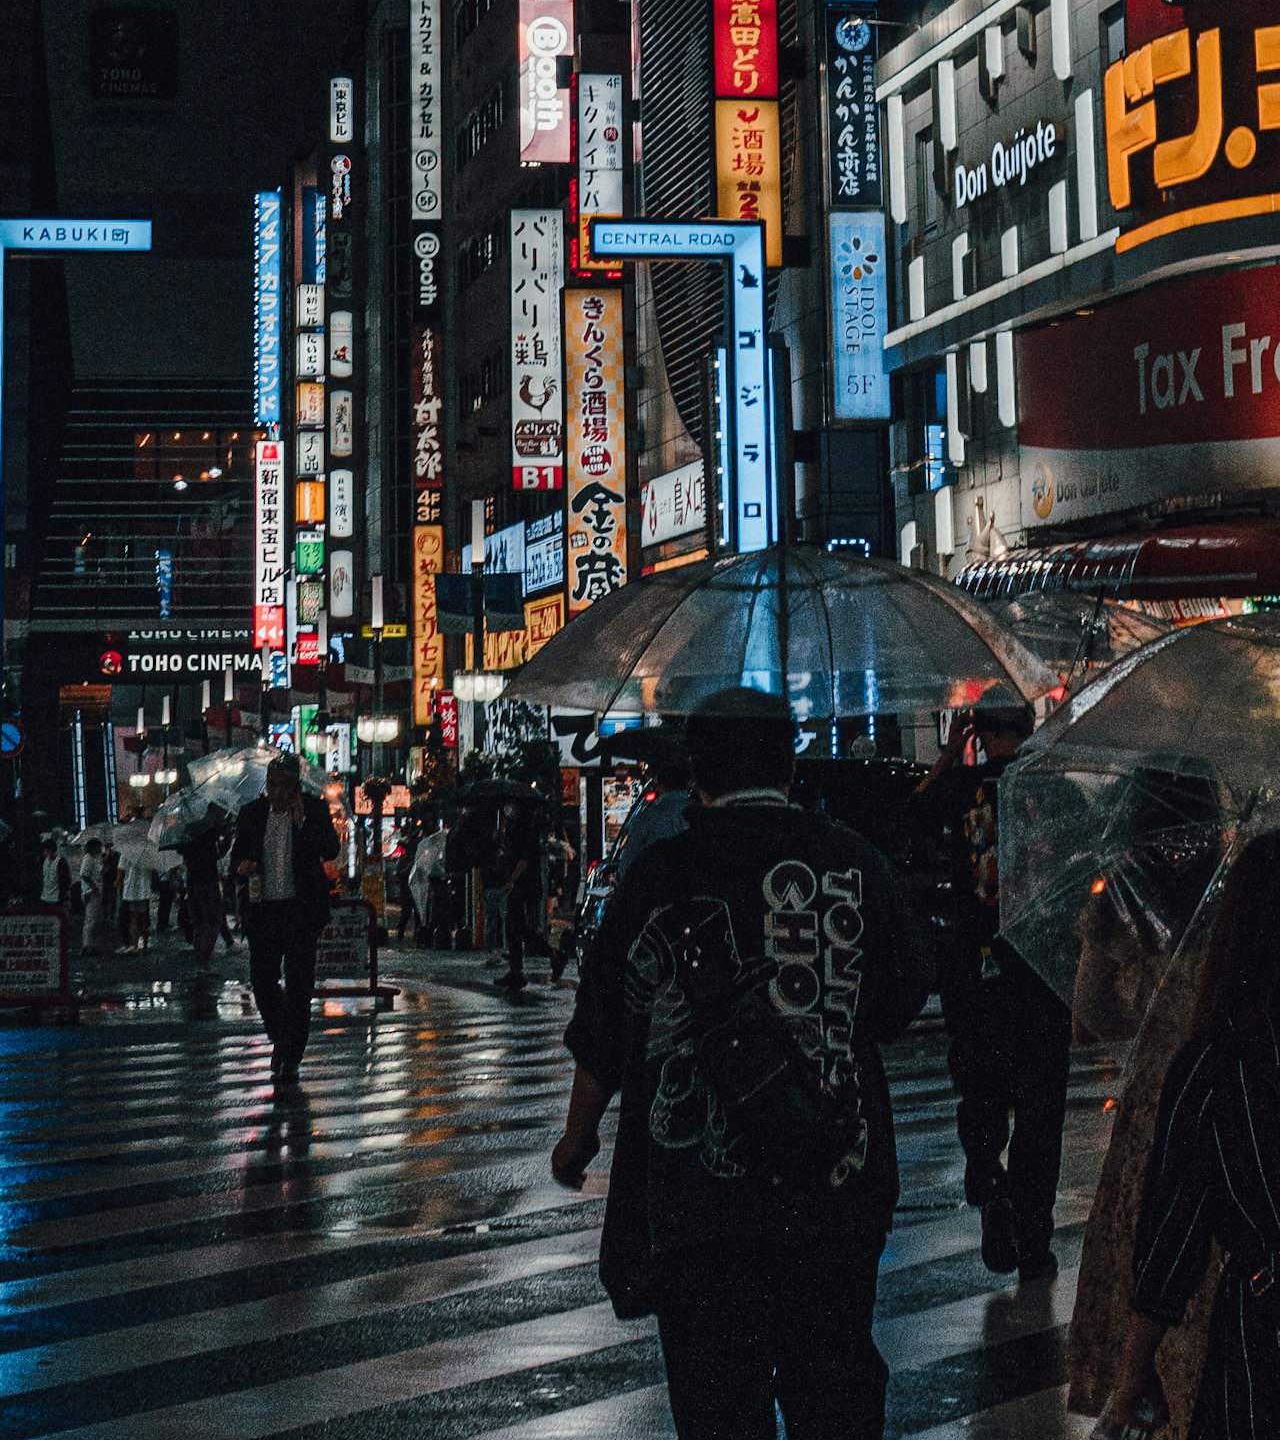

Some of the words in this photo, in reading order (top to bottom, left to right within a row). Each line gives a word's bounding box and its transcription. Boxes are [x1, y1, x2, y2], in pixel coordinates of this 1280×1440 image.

[525, 16, 568, 132] Booth
[605, 77, 620, 89] 4F
[335, 90, 348, 136] 東京ビル
[834, 54, 861, 196] かんかん商店
[732, 127, 767, 176] 酒場
[953, 150, 987, 210] Don
[990, 117, 1056, 192] Quijote
[414, 232, 440, 306] Booth
[602, 232, 683, 247] CENTRAL
[688, 232, 735, 247] ROAD
[844, 286, 861, 354] STAGE
[859, 286, 876, 340] IDOL
[581, 296, 608, 443] きんくら酒場
[846, 374, 876, 395] 5F
[1133, 340, 1203, 415] Tax
[413, 396, 442, 480] 甘太郎
[416, 489, 441, 506] 4F
[522, 466, 555, 489] B1
[261, 468, 279, 604] 新宿東宝ビル店
[416, 506, 441, 522] 3F
[571, 481, 625, 602] 金の蔵
[127, 654, 182, 672] TOHO
[186, 653, 266, 672] CINEMA
